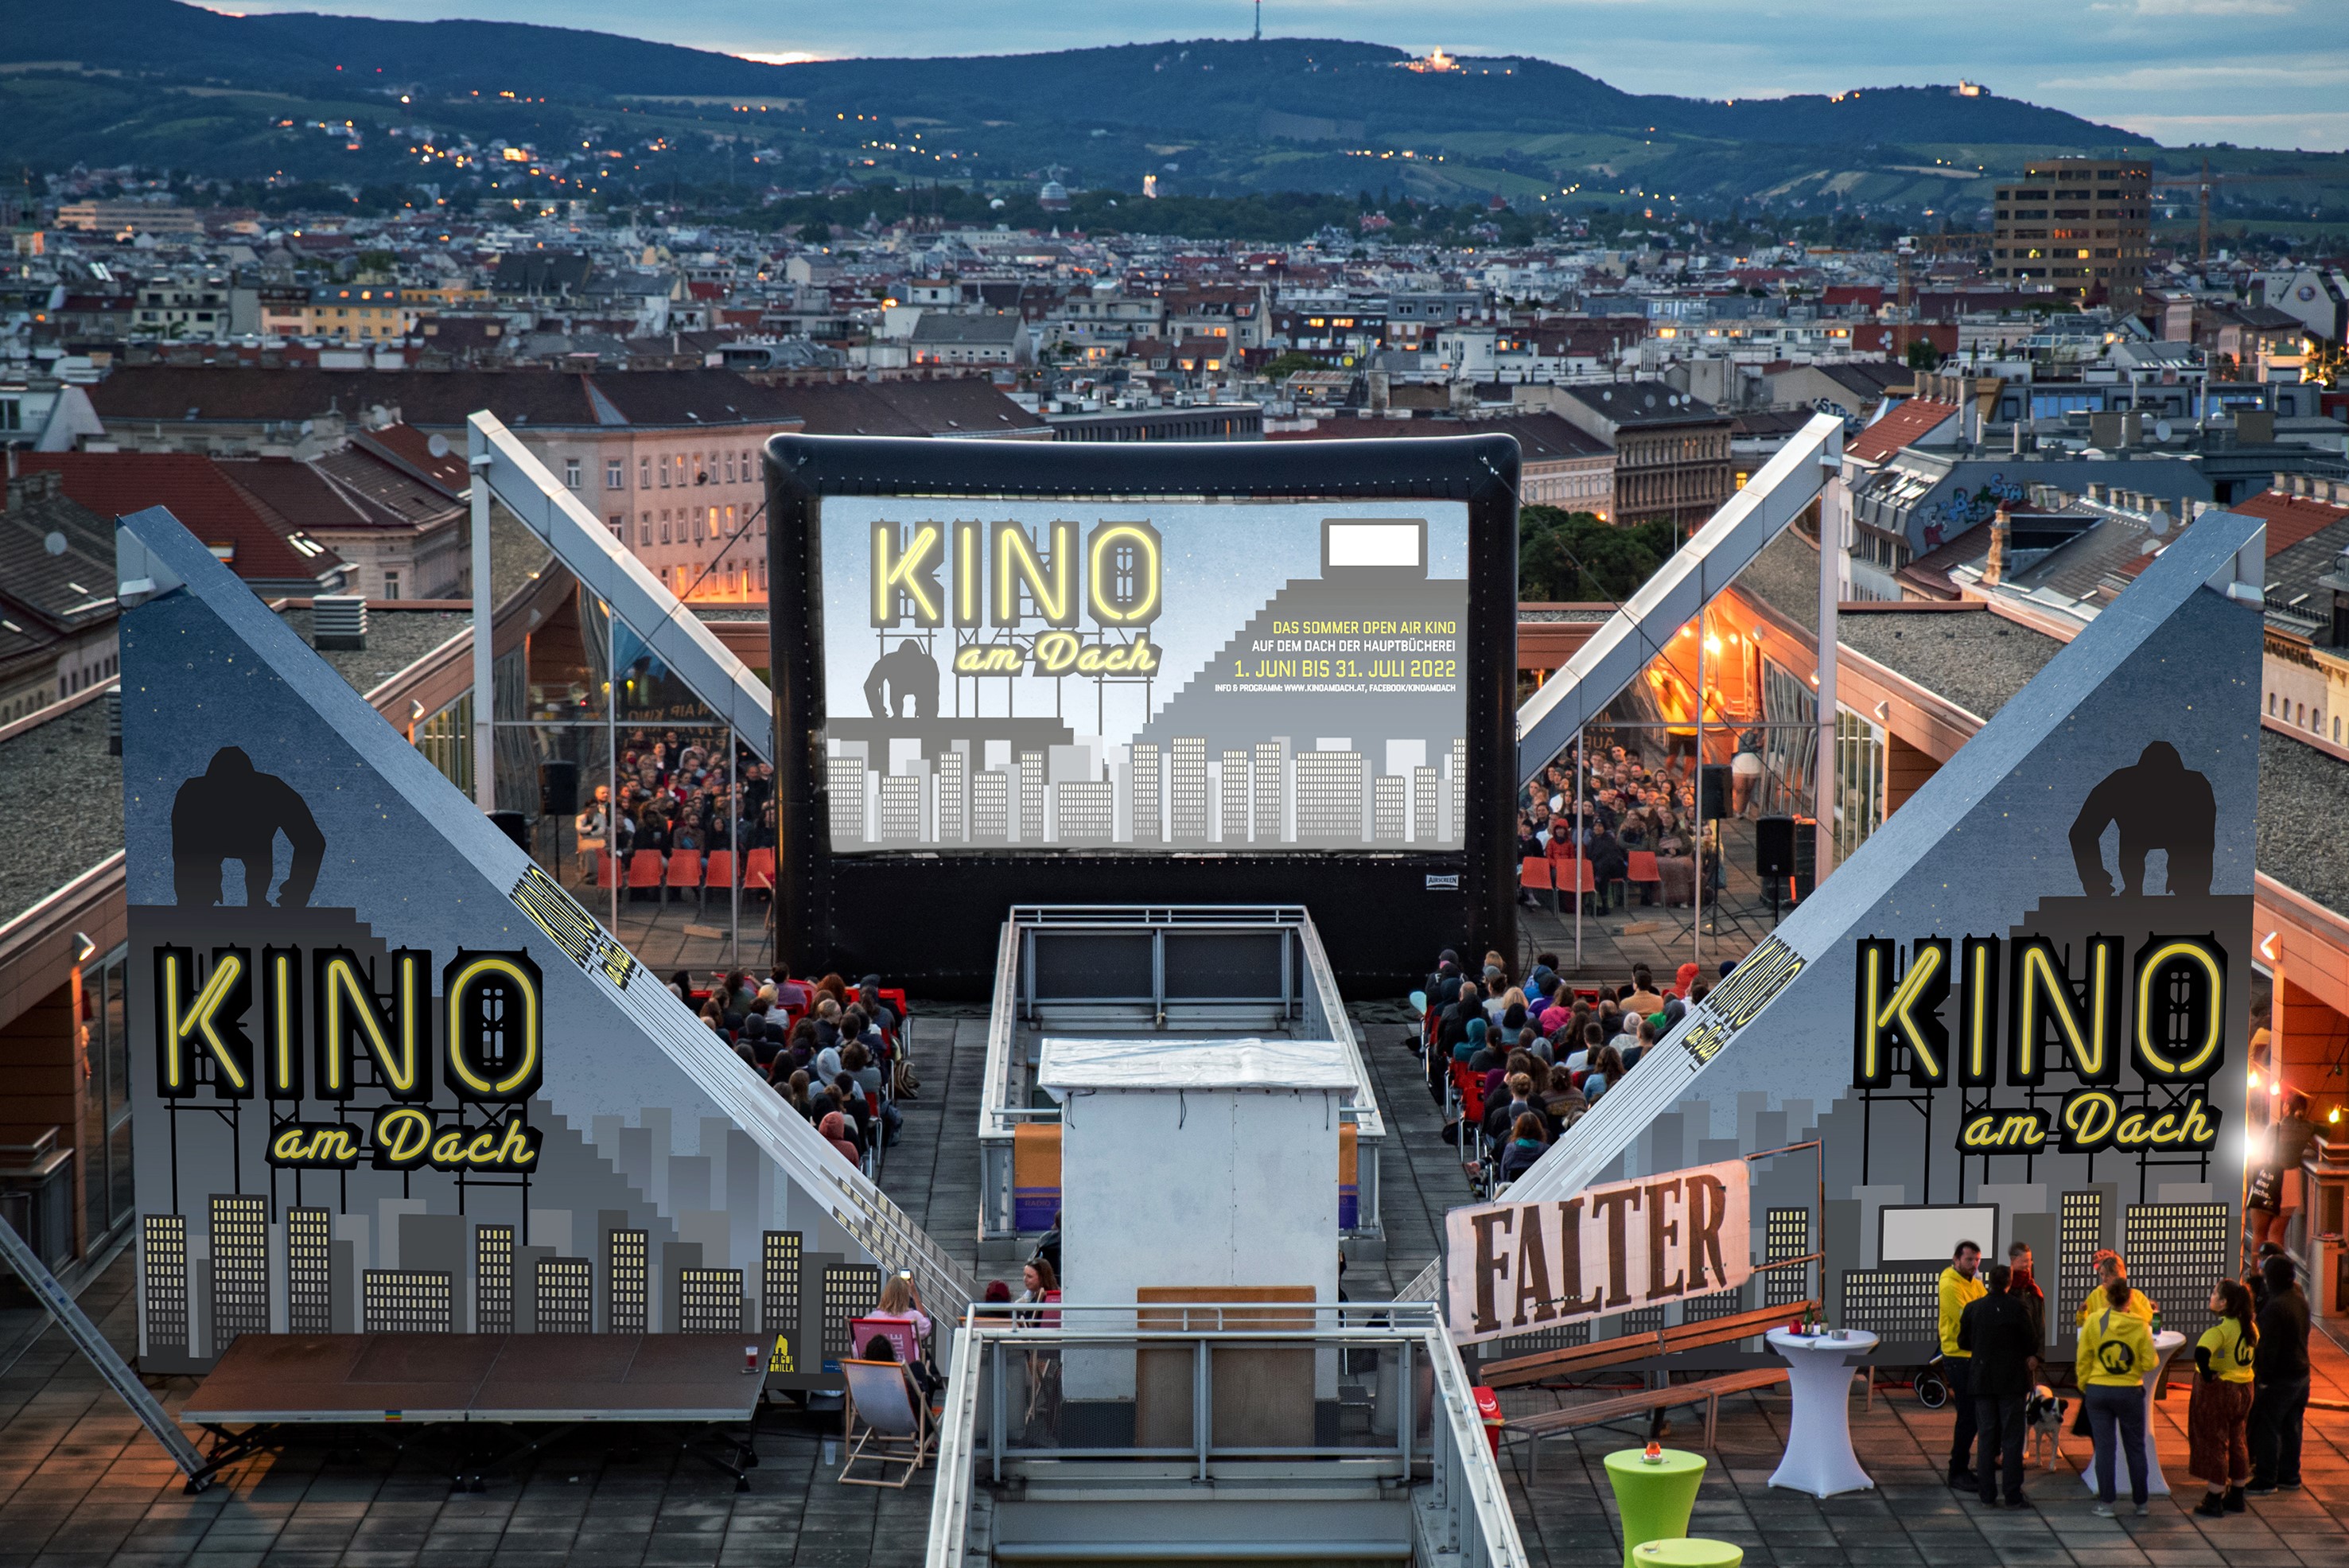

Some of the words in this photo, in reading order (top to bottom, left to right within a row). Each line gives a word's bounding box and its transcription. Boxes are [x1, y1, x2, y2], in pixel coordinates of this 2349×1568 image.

[877, 524, 1159, 622] KINO
[958, 647, 1023, 671] am
[1036, 632, 1157, 671] Dach
[1252, 640, 1274, 652] AUF
[1277, 640, 1302, 652] DEM
[1305, 640, 1336, 652] DACH
[1339, 640, 1361, 652] DER
[1363, 637, 1456, 652] HAUPTBÜCHEREI
[1273, 621, 1299, 634] DAS
[1302, 621, 1359, 634] SOMMER
[1363, 621, 1397, 634] OPEN
[1400, 621, 1421, 634] AIR
[1425, 621, 1456, 634] KINO
[1215, 683, 1231, 692] INFO
[1232, 683, 1238, 692] &
[1239, 683, 1283, 692] PROGRAMM:
[1369, 683, 1456, 692] FACEBOOK/KINOAMDACH
[1234, 659, 1250, 678] 1.
[1255, 659, 1297, 678] JUNI
[1302, 659, 1330, 678] BIS
[1336, 659, 1363, 678] 31.
[1368, 659, 1405, 678] JULI
[1410, 659, 1456, 678] 2022
[163, 953, 539, 1094] KINO
[1862, 940, 2223, 1080] KINO
[272, 1127, 360, 1161] am
[375, 1107, 536, 1165] Dach
[1962, 1114, 2047, 1148] am
[2063, 1091, 2216, 1146] Dach
[1471, 1173, 1728, 1335] FALTER
